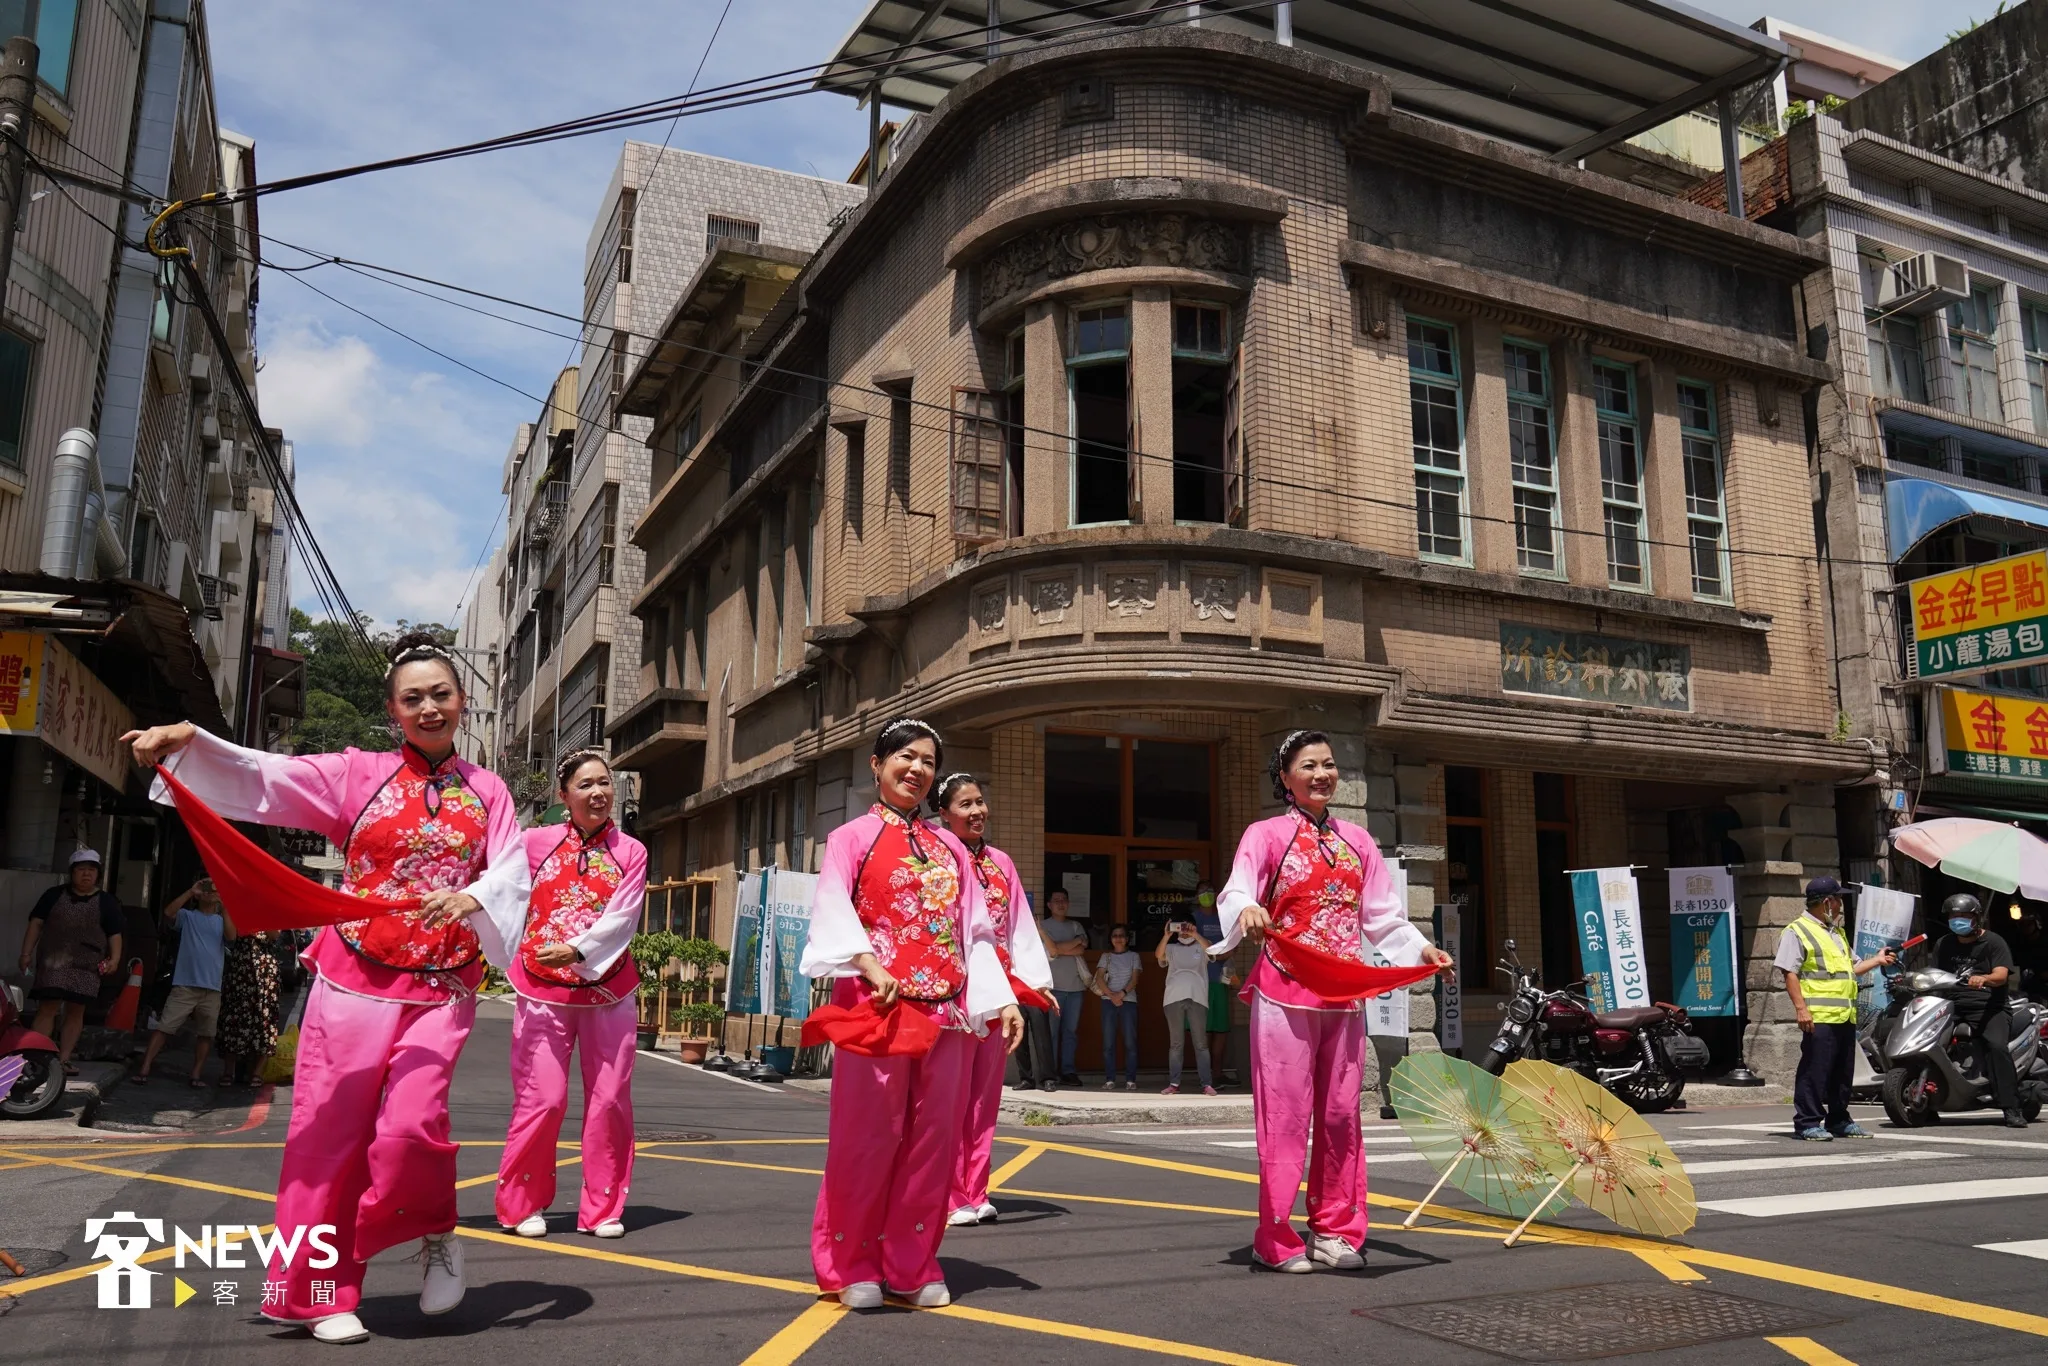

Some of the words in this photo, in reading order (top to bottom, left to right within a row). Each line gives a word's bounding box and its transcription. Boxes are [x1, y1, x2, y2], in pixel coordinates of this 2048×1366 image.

[1917, 561, 2046, 631] 金金早點
[1928, 623, 2045, 670] 小籠湯包
[1503, 635, 1687, 702] 張外科診所
[1147, 903, 1172, 914] Café
[1451, 893, 1469, 904] Café
[1674, 899, 1727, 912] 長春1930
[1584, 911, 1604, 951] Café
[1687, 915, 1715, 927] Café
[1612, 909, 1644, 1000] 長春1930
[1694, 931, 1713, 1000] 即將開幕
[1380, 1005, 1390, 1026] 咖啡
